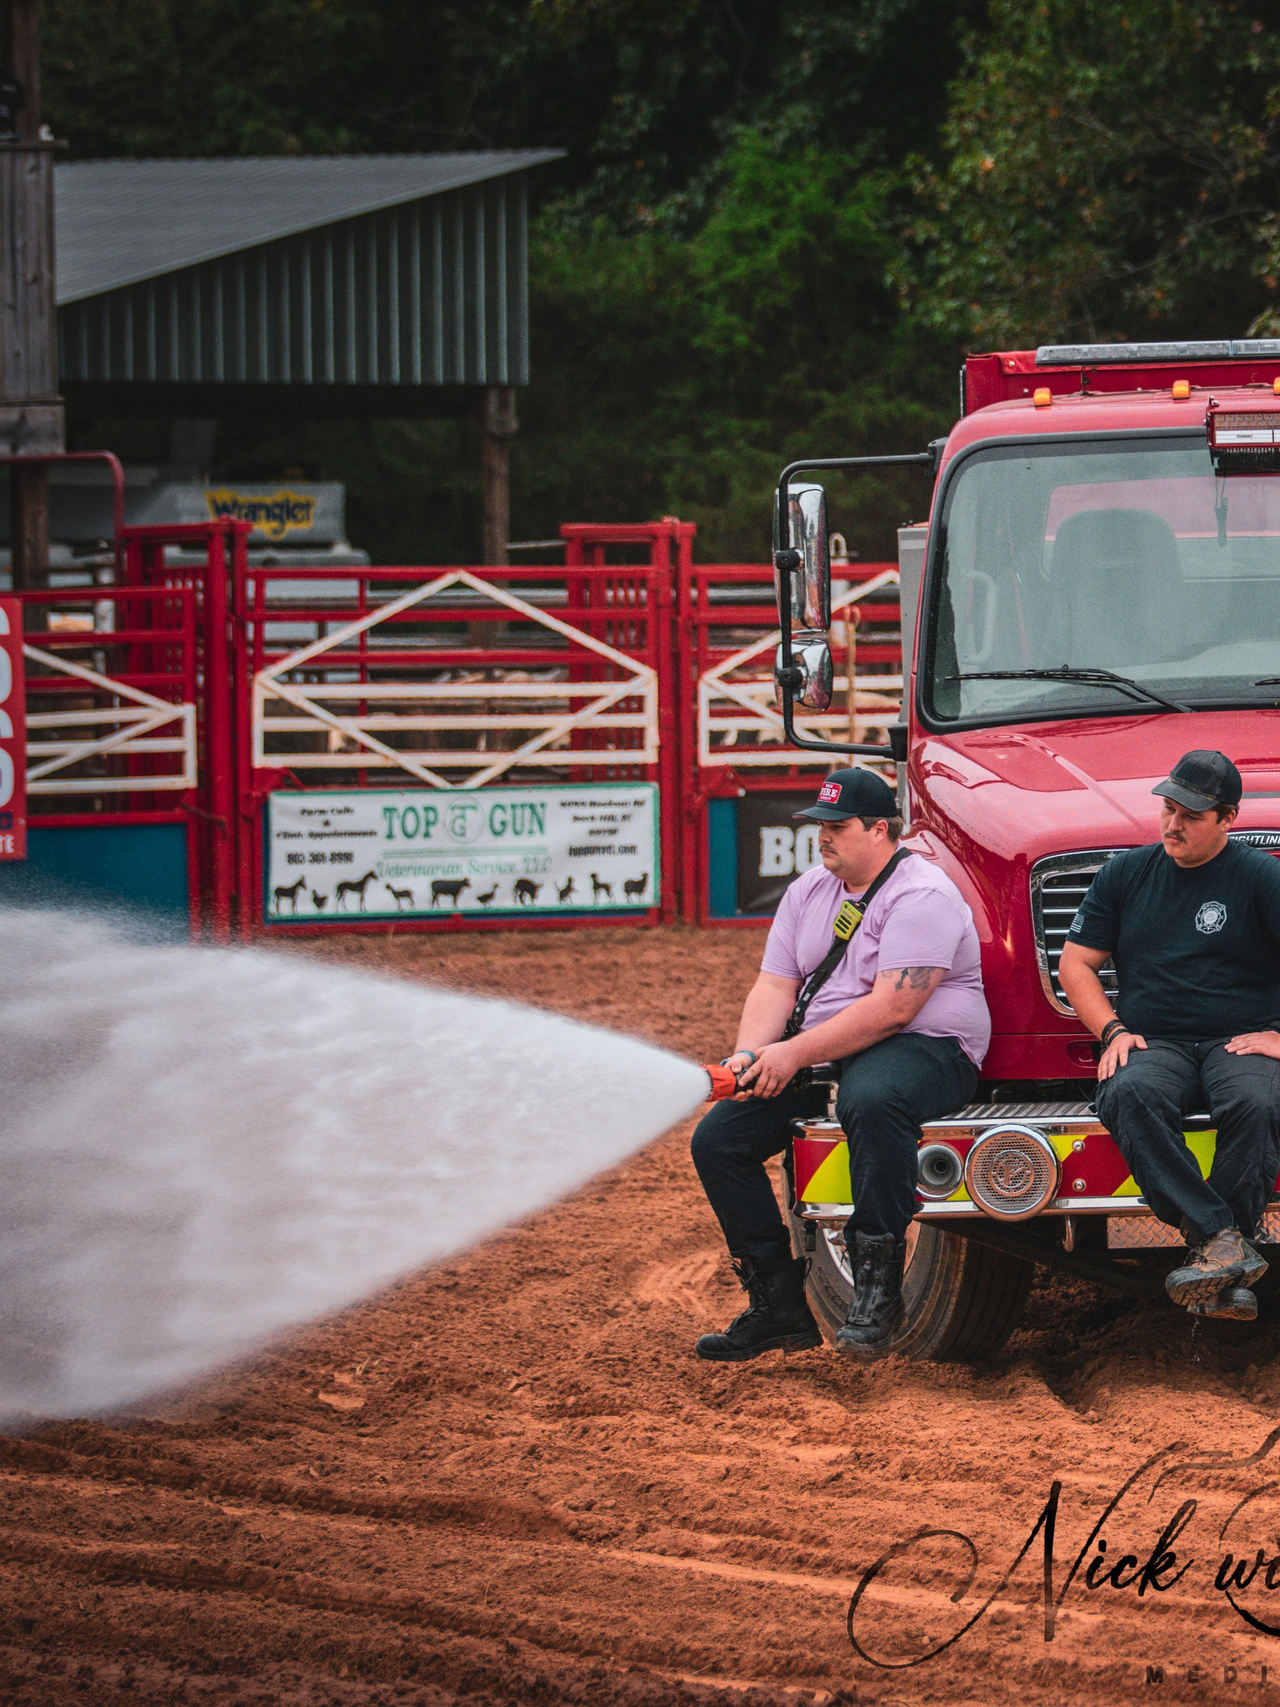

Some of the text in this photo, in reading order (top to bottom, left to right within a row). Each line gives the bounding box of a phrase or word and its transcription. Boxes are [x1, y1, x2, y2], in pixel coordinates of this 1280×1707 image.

[211, 497, 311, 536] Wrangler
[383, 801, 547, 840] TOP GUN
[376, 860, 463, 878] Veterinarian
[521, 855, 553, 875] LLC
